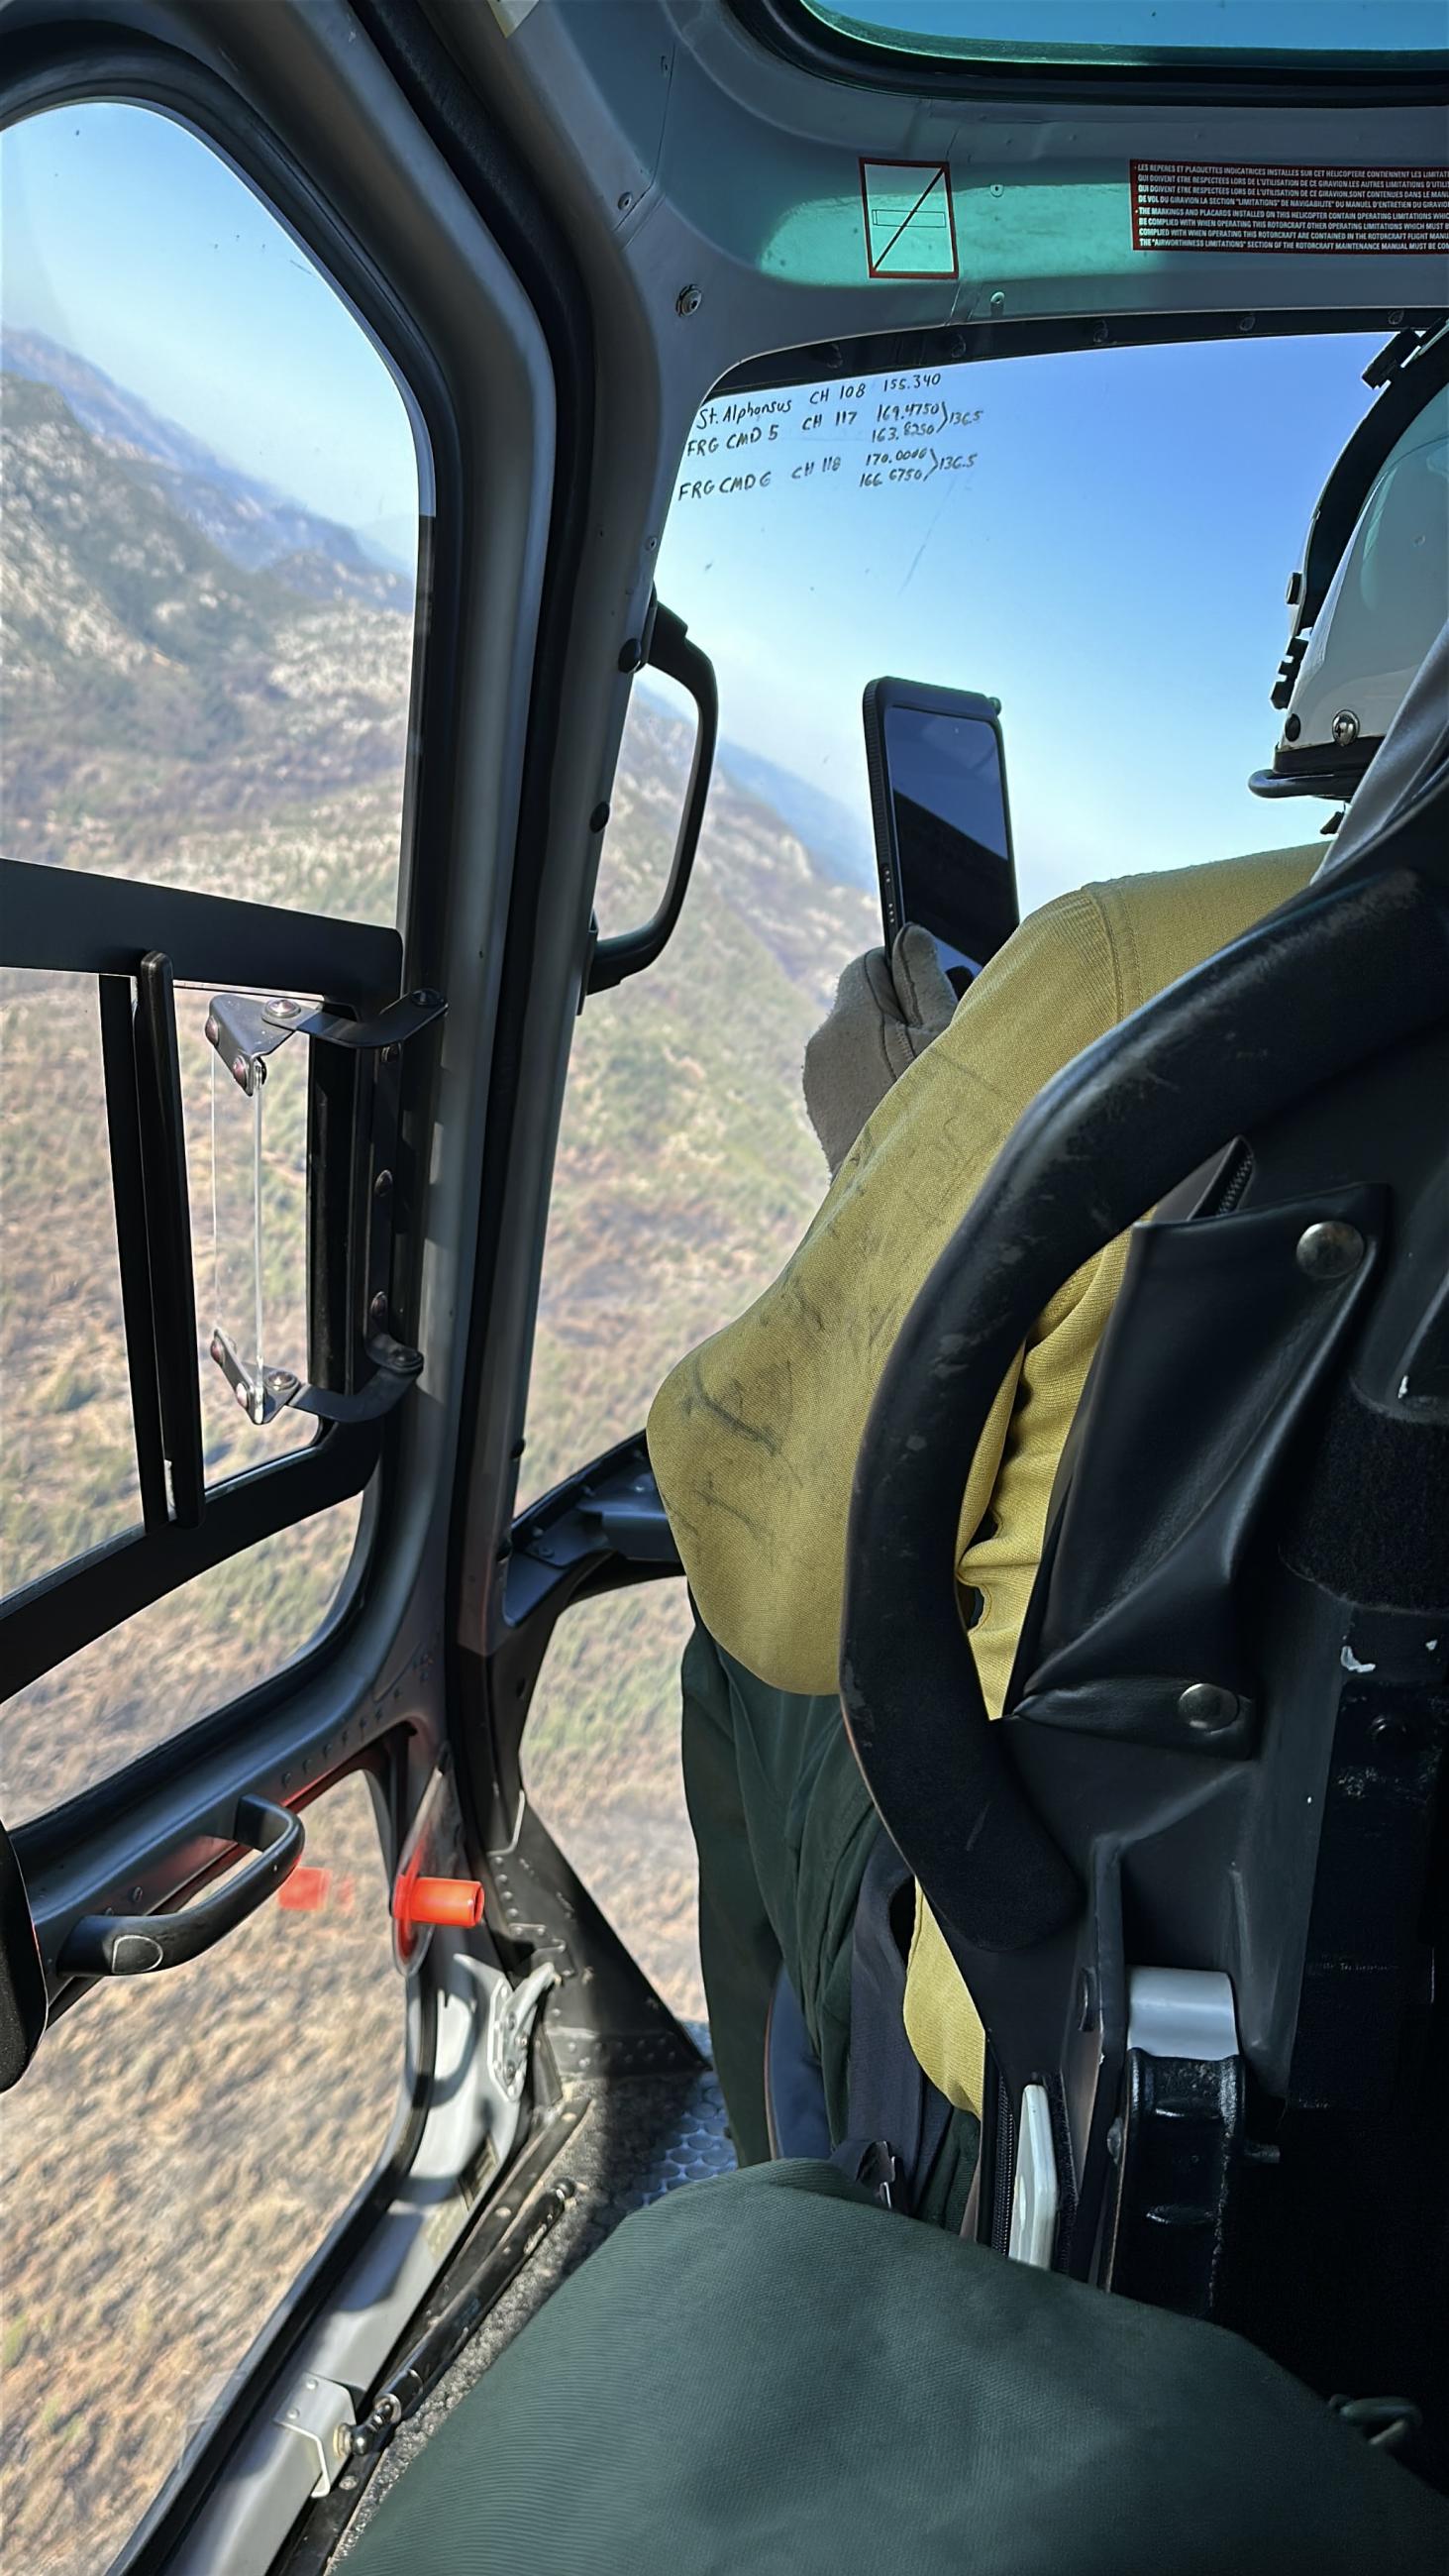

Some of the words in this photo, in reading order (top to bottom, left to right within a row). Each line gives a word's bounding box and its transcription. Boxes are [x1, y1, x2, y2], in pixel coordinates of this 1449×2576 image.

[1150, 174, 1176, 183] DOIVENT
[1192, 176, 1229, 185] RESPECTEES
[1185, 165, 1223, 174] PLAQUETTES
[1224, 166, 1266, 175] INDICATRICES
[1192, 186, 1229, 195] RESPECTEES
[696, 407, 719, 430] St.
[722, 399, 792, 425] Alphonsus
[809, 387, 830, 404] CH
[839, 383, 867, 399] 108
[883, 373, 941, 392] 155.340
[687, 437, 719, 457] FRG
[726, 426, 762, 449] CMD
[768, 424, 779, 441] 5
[801, 413, 823, 431] CH
[835, 411, 858, 426] 117
[678, 480, 715, 501] FRG
[719, 474, 756, 493] CMD
[791, 461, 815, 480] CH
[822, 456, 842, 473] 118
